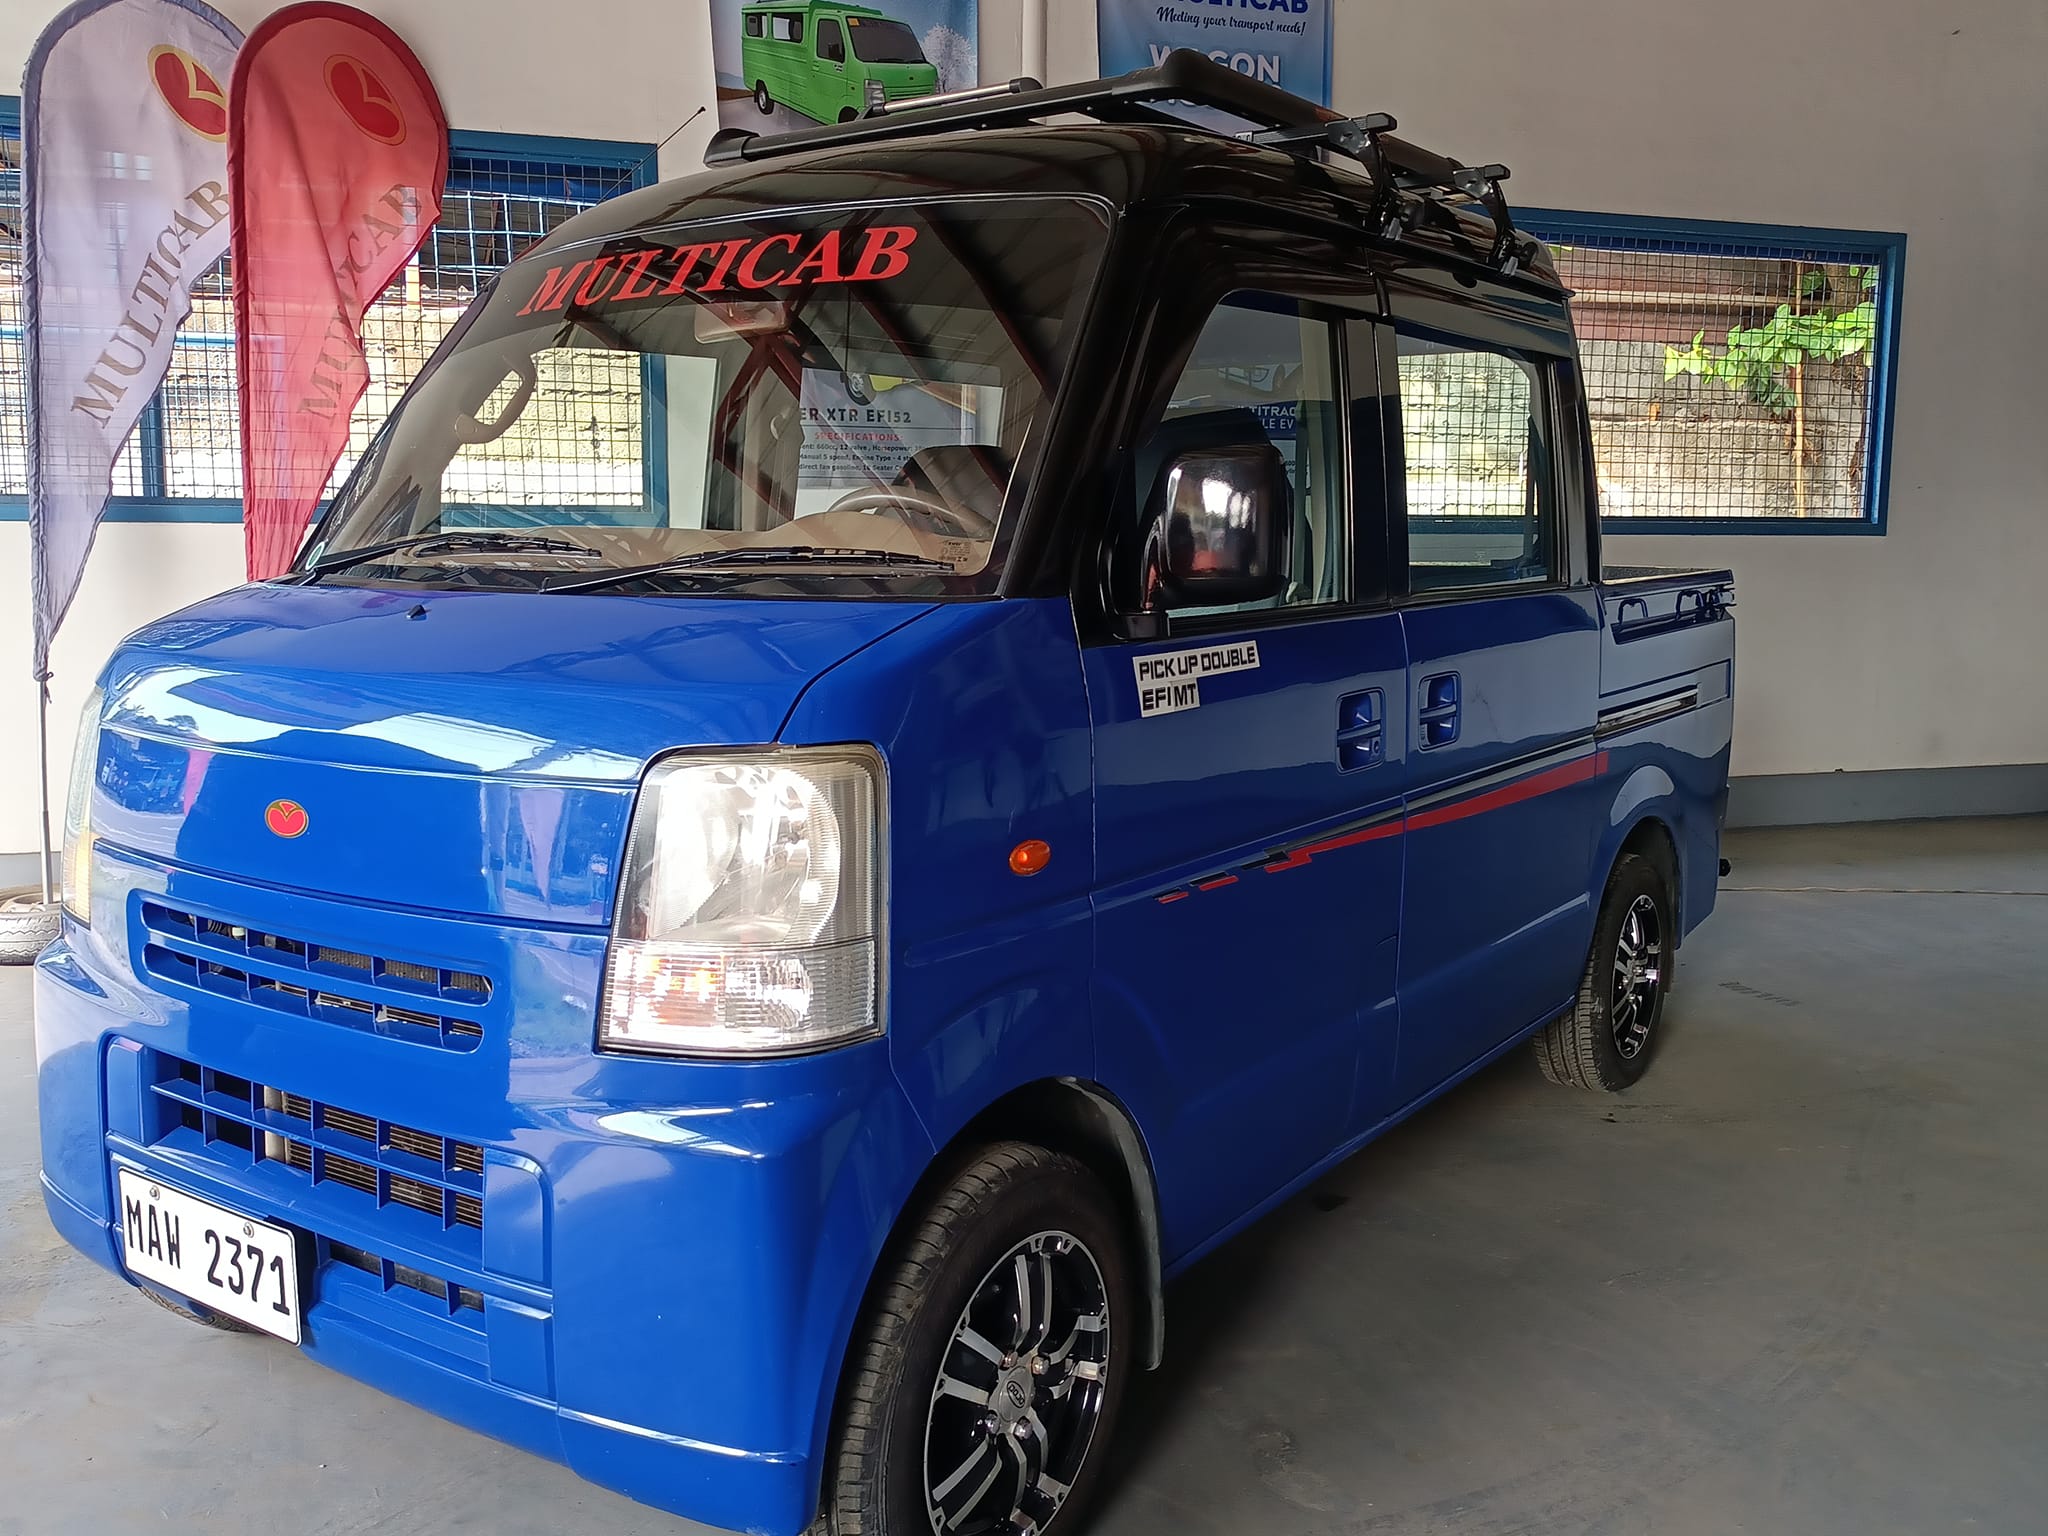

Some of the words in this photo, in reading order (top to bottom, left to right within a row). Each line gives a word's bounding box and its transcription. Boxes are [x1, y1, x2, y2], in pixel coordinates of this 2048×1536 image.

[1156, 6, 1200, 28] Meeting
[1203, 14, 1227, 29] your
[1229, 16, 1275, 34] transport
[1276, 21, 1307, 36] needs!
[1149, 44, 1280, 83] WGON
[516, 226, 919, 317] MULTICAB
[827, 408, 859, 422] XTR
[1138, 657, 1177, 682] PICK
[1177, 654, 1199, 675] UP
[1200, 646, 1256, 672] DOUBLE
[1142, 686, 1172, 711] EFI
[1173, 683, 1197, 708] MT
[125, 1195, 181, 1270] MAW
[204, 1229, 290, 1316] 2371
